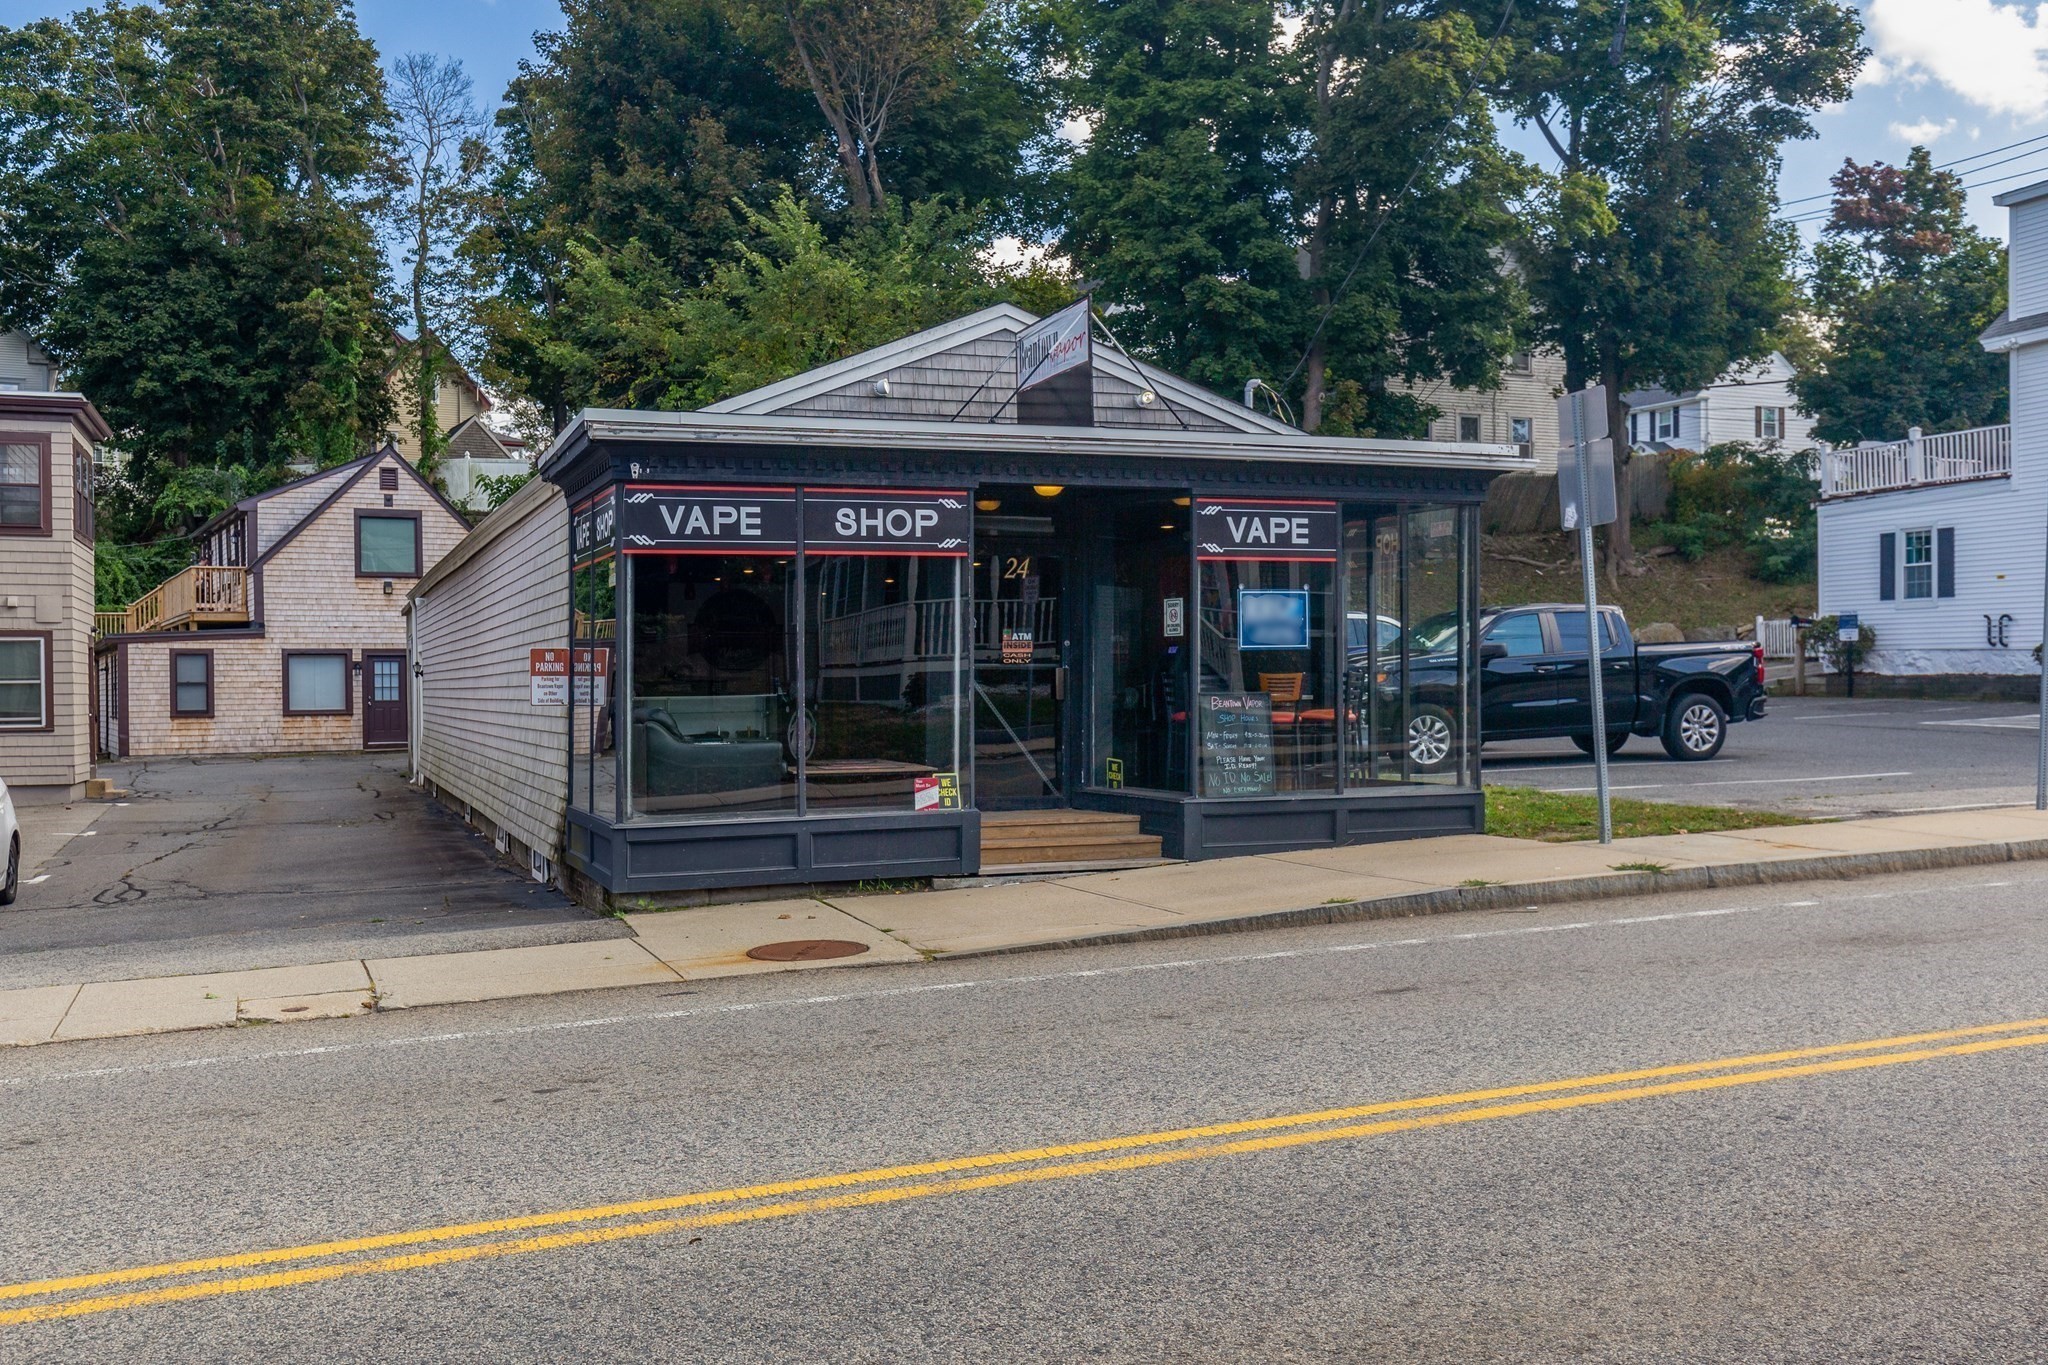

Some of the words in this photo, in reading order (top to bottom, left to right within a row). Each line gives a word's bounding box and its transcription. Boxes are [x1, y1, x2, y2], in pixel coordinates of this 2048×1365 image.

[659, 505, 761, 535] VAPE
[835, 507, 939, 537] SHOP
[575, 520, 590, 550] VAPE
[596, 509, 613, 541] SHOP
[1226, 516, 1309, 544] VAPE
[1004, 557, 1030, 579] 24
[1012, 632, 1032, 640] ATM
[1003, 641, 1032, 649] INSIDE
[545, 652, 555, 661] NO
[535, 662, 564, 672] PARKING
[940, 778, 951, 787] WE
[944, 798, 951, 806] ID
